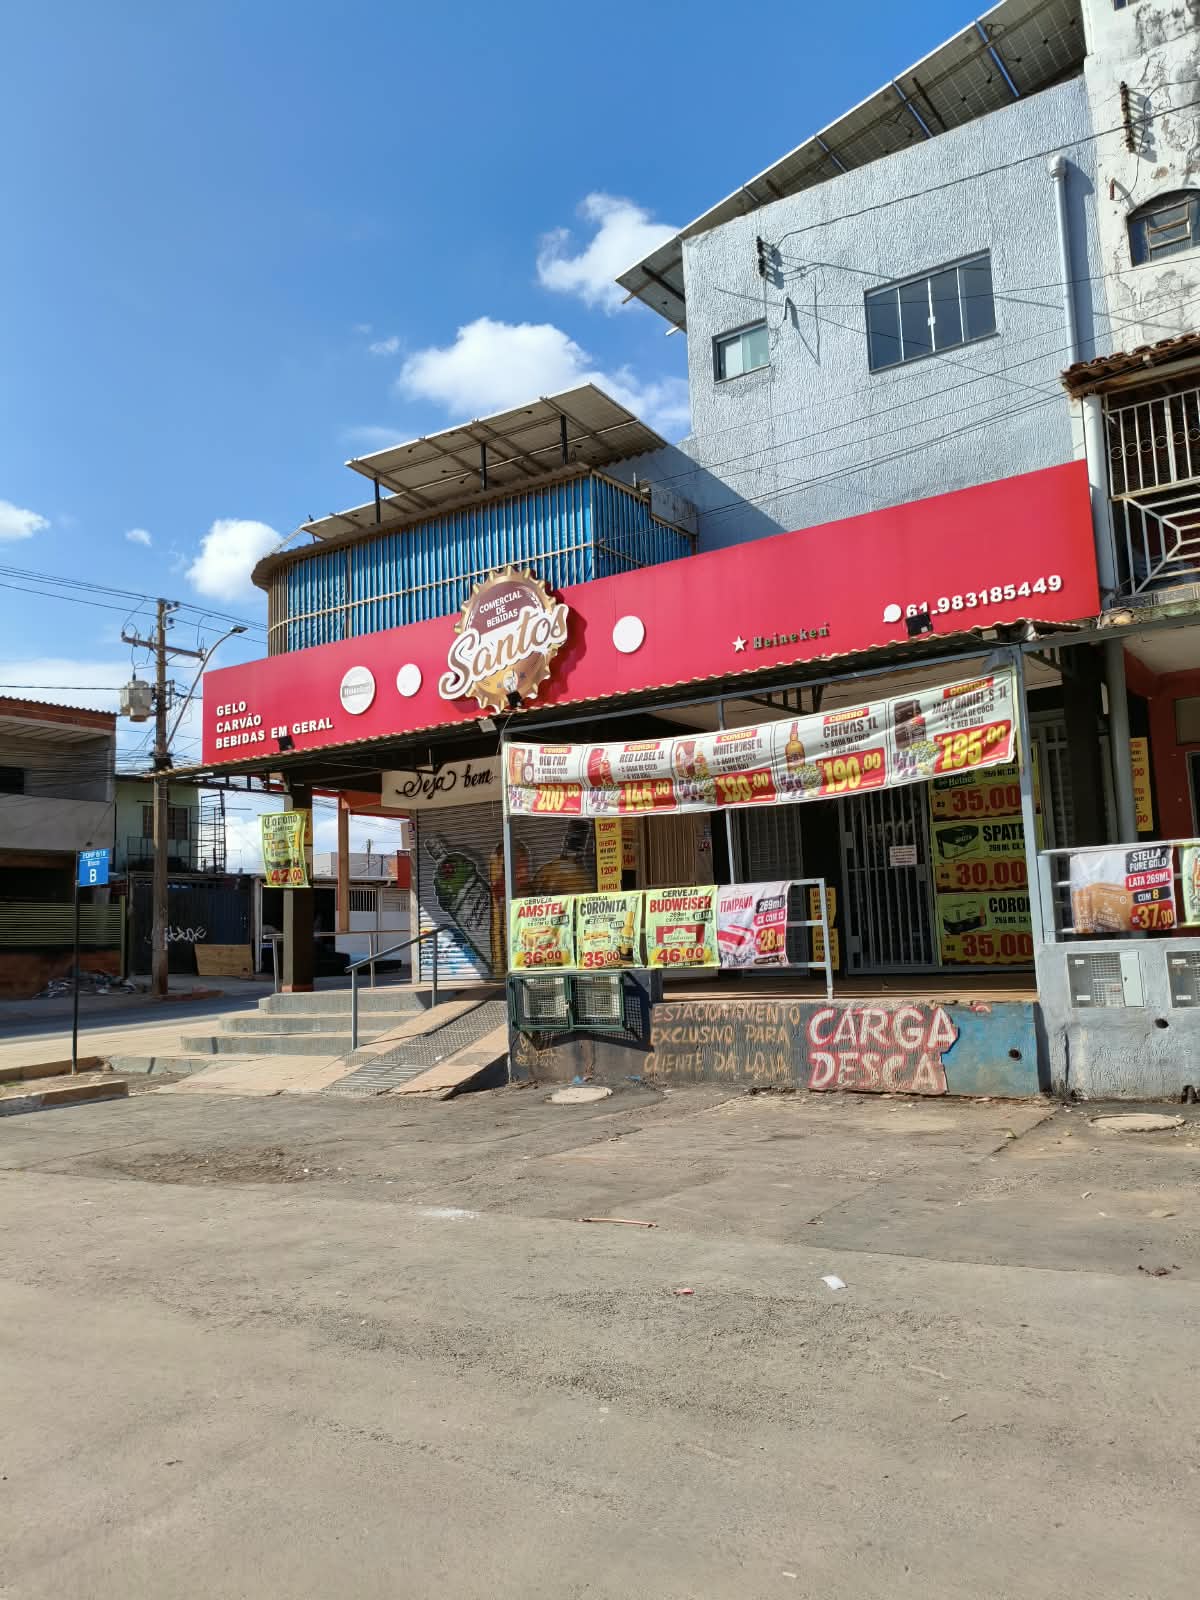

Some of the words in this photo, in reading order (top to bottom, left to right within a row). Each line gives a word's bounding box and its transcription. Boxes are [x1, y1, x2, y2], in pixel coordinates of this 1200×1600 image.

[480, 591, 522, 613] COMERCIAL
[496, 605, 506, 615] DE
[486, 609, 518, 627] BEBIDAS
[753, 626, 828, 649] Heineken
[439, 604, 569, 699] Santos
[216, 701, 247, 717] GELO
[216, 713, 262, 734] CARVÃO
[823, 721, 864, 738] CHIVAS
[868, 717, 878, 730] 1L
[215, 730, 265, 749] BEBIDAS
[271, 726, 288, 739] EM
[292, 718, 333, 735] GERAL
[713, 743, 733, 756] WHITE
[942, 725, 1007, 769] 195,00
[635, 751, 656, 762] LABEL
[824, 753, 881, 793] 190,00
[395, 771, 456, 799] Seja
[952, 785, 1020, 812] 35,00
[1132, 847, 1161, 861] STELLA
[1129, 861, 1147, 872] PURE
[1148, 857, 1167, 869] GOLD
[89, 868, 97, 883] B
[956, 862, 1027, 886] 30,00
[1128, 876, 1145, 887] LATA
[1146, 872, 1170, 885] 269ML
[524, 897, 552, 905] CERVEJA
[661, 889, 699, 897] CERVEJA
[1138, 893, 1151, 902] COM
[1152, 889, 1159, 899] 8
[518, 901, 566, 918] AMSTEL
[580, 899, 628, 917] CORONITA
[650, 896, 712, 913] BUDWEISER
[720, 896, 753, 912] ITAIPAVA
[759, 897, 782, 912] 269ml
[961, 933, 1032, 959] 35,00
[650, 1024, 733, 1046] EXCLUSIVO
[745, 1023, 791, 1047] PARA
[806, 1004, 959, 1050] CARGA
[643, 1049, 703, 1073] CLIENTE
[714, 1052, 736, 1073] DA
